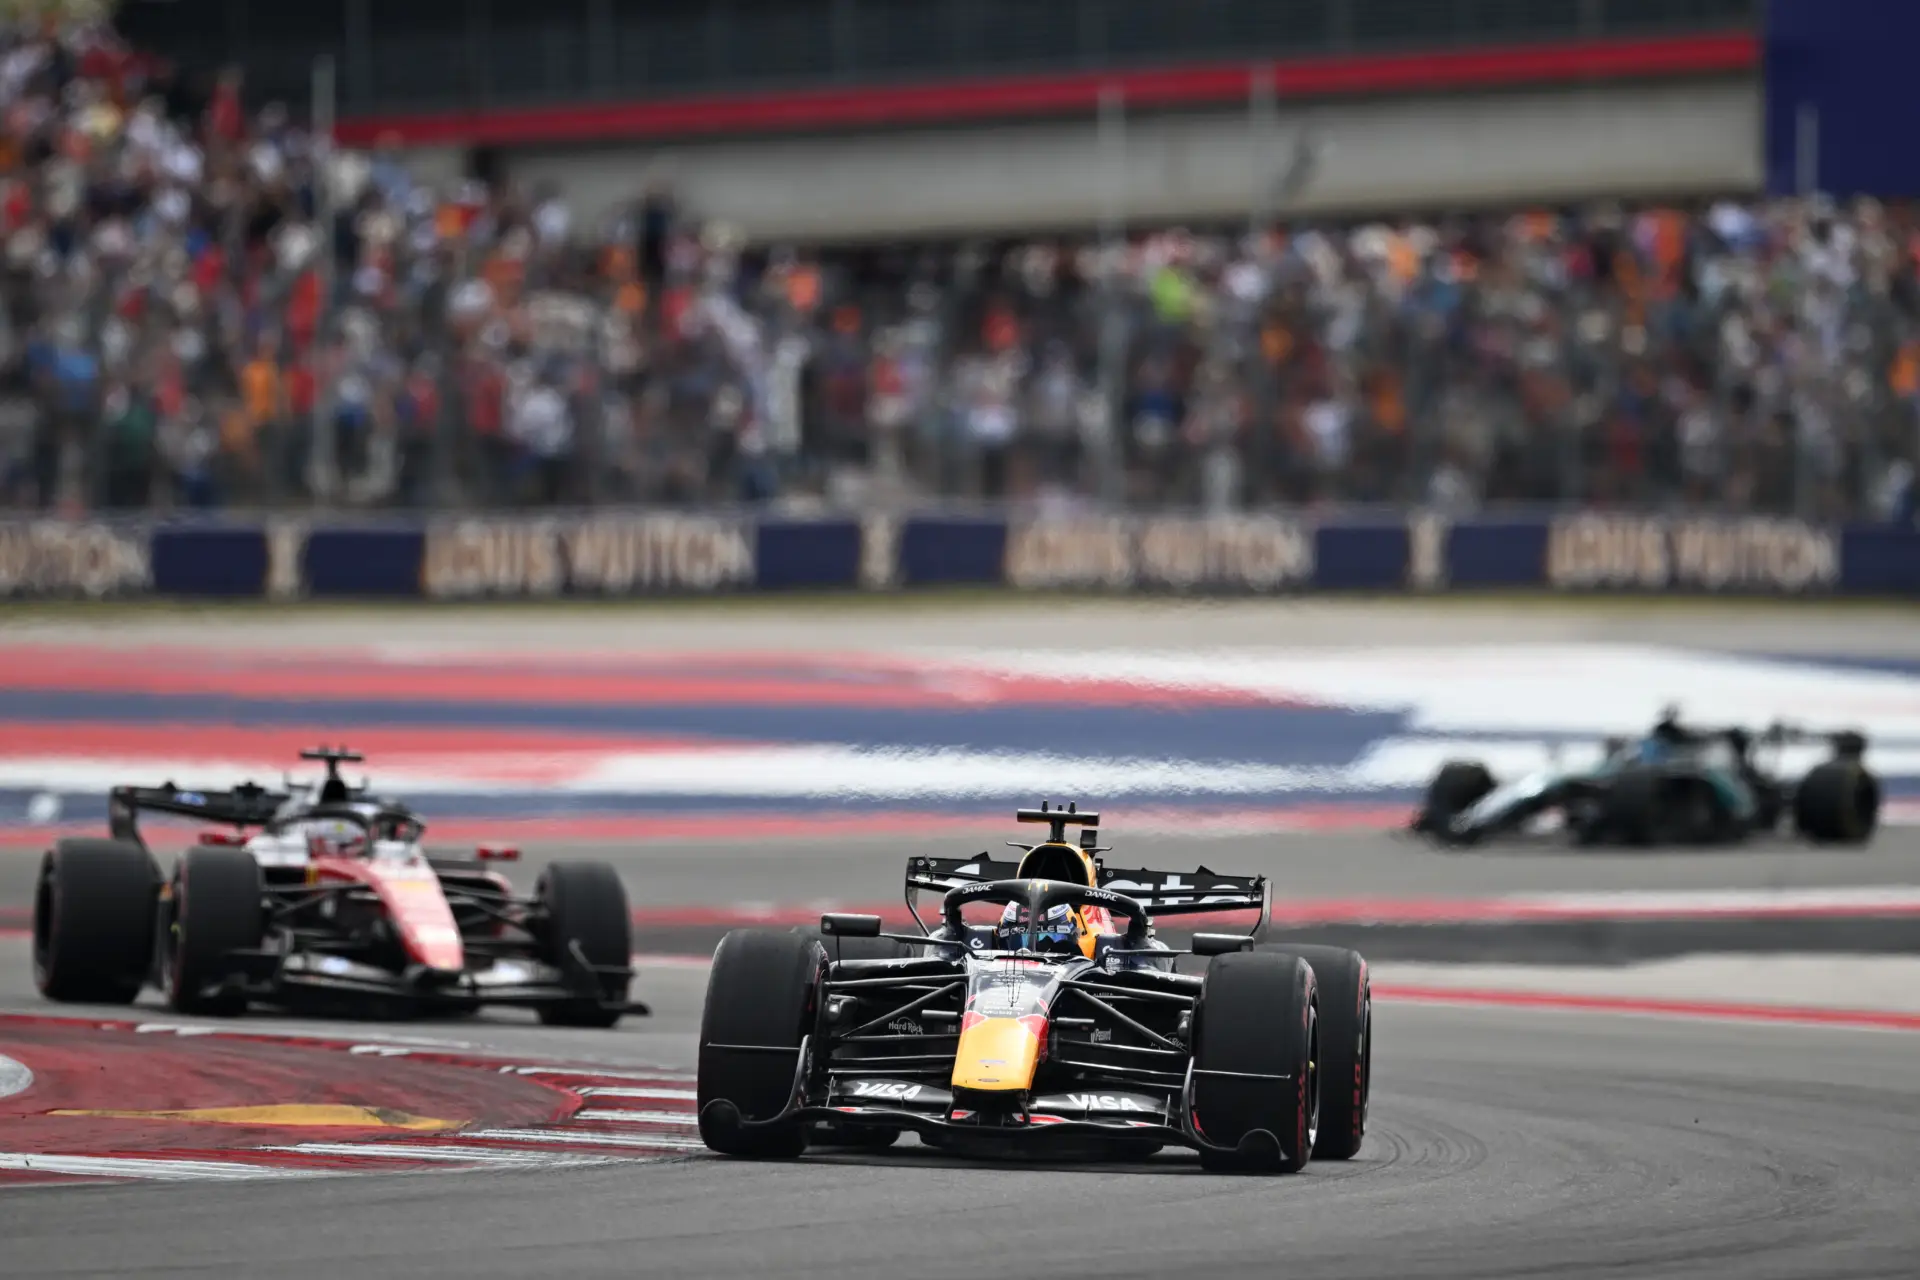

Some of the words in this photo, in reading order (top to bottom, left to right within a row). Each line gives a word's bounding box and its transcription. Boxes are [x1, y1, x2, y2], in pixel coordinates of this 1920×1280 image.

[961, 884, 994, 894] DAMAC
[1084, 890, 1118, 902] DAMAC
[888, 1020, 907, 1031] Hard
[907, 1022, 923, 1034] Rock
[854, 1082, 922, 1099] VISA
[1066, 1093, 1144, 1112] VISA
